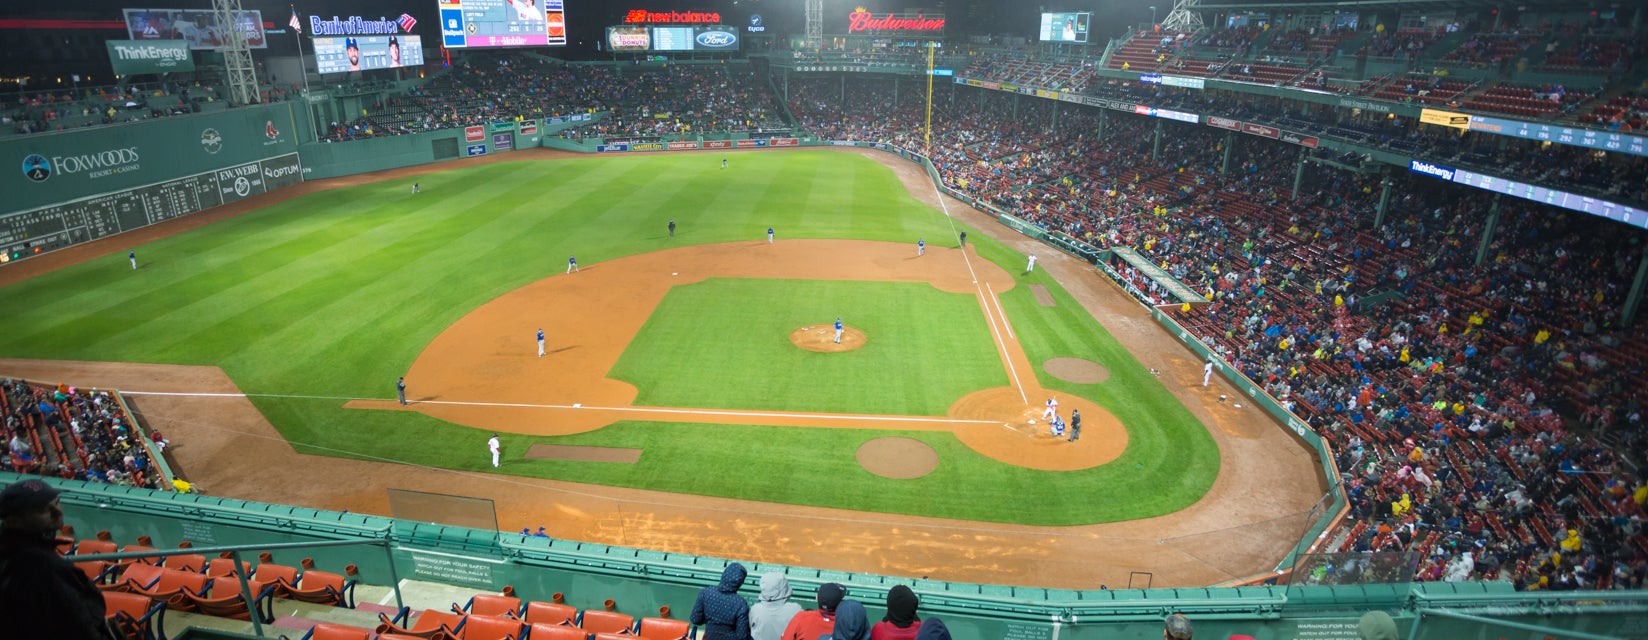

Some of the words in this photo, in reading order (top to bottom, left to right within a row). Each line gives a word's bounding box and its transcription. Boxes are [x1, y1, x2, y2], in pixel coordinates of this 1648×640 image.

[648, 12, 671, 23] new
[672, 10, 720, 23] balance
[848, 12, 945, 31] Budweiser
[310, 16, 344, 35] Bank
[344, 16, 356, 35] of
[356, 16, 398, 34] America
[704, 33, 728, 44] Ford
[114, 46, 188, 60] ThinkEnergy
[52, 146, 139, 175] FOXWOODS
[89, 170, 113, 179] RESORT
[117, 164, 140, 174] CASINO
[235, 164, 258, 177] WEBB
[273, 164, 298, 177] OPTUM
[1412, 160, 1454, 180] ThinkEnergy
